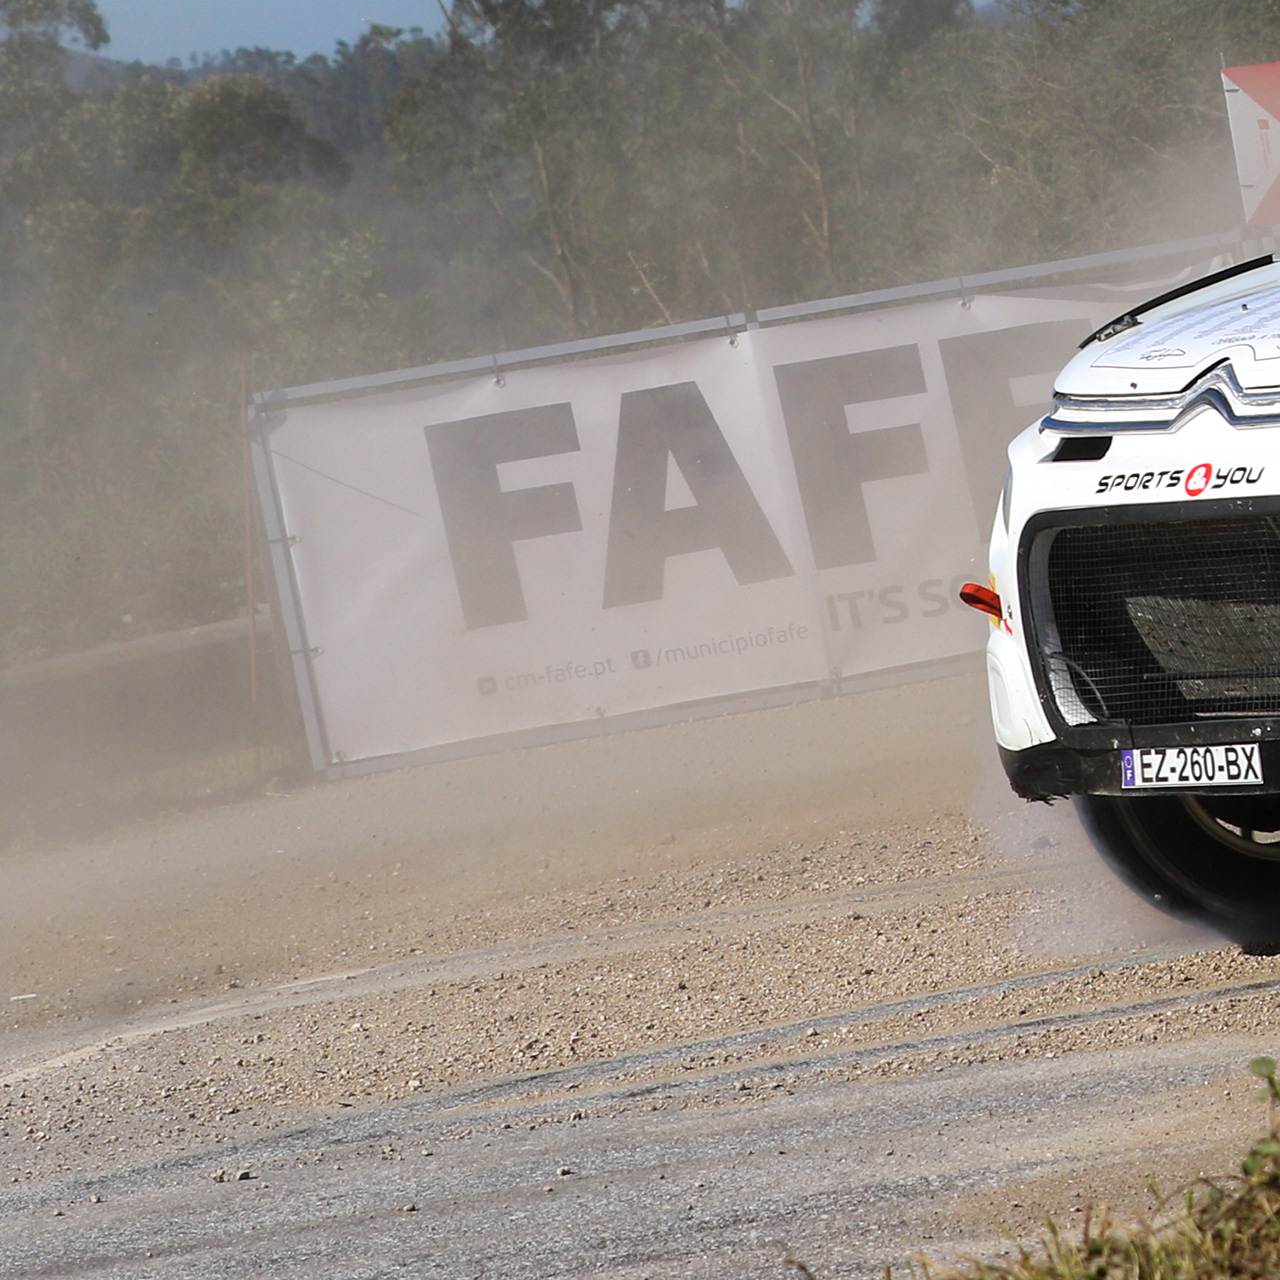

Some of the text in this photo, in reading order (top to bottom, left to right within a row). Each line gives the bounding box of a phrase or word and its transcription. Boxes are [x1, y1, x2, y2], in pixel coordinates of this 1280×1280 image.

[825, 584, 910, 633] IT'S
[504, 656, 616, 692] cm-fafe.pt
[1140, 746, 1260, 783] EZ-260-BX
